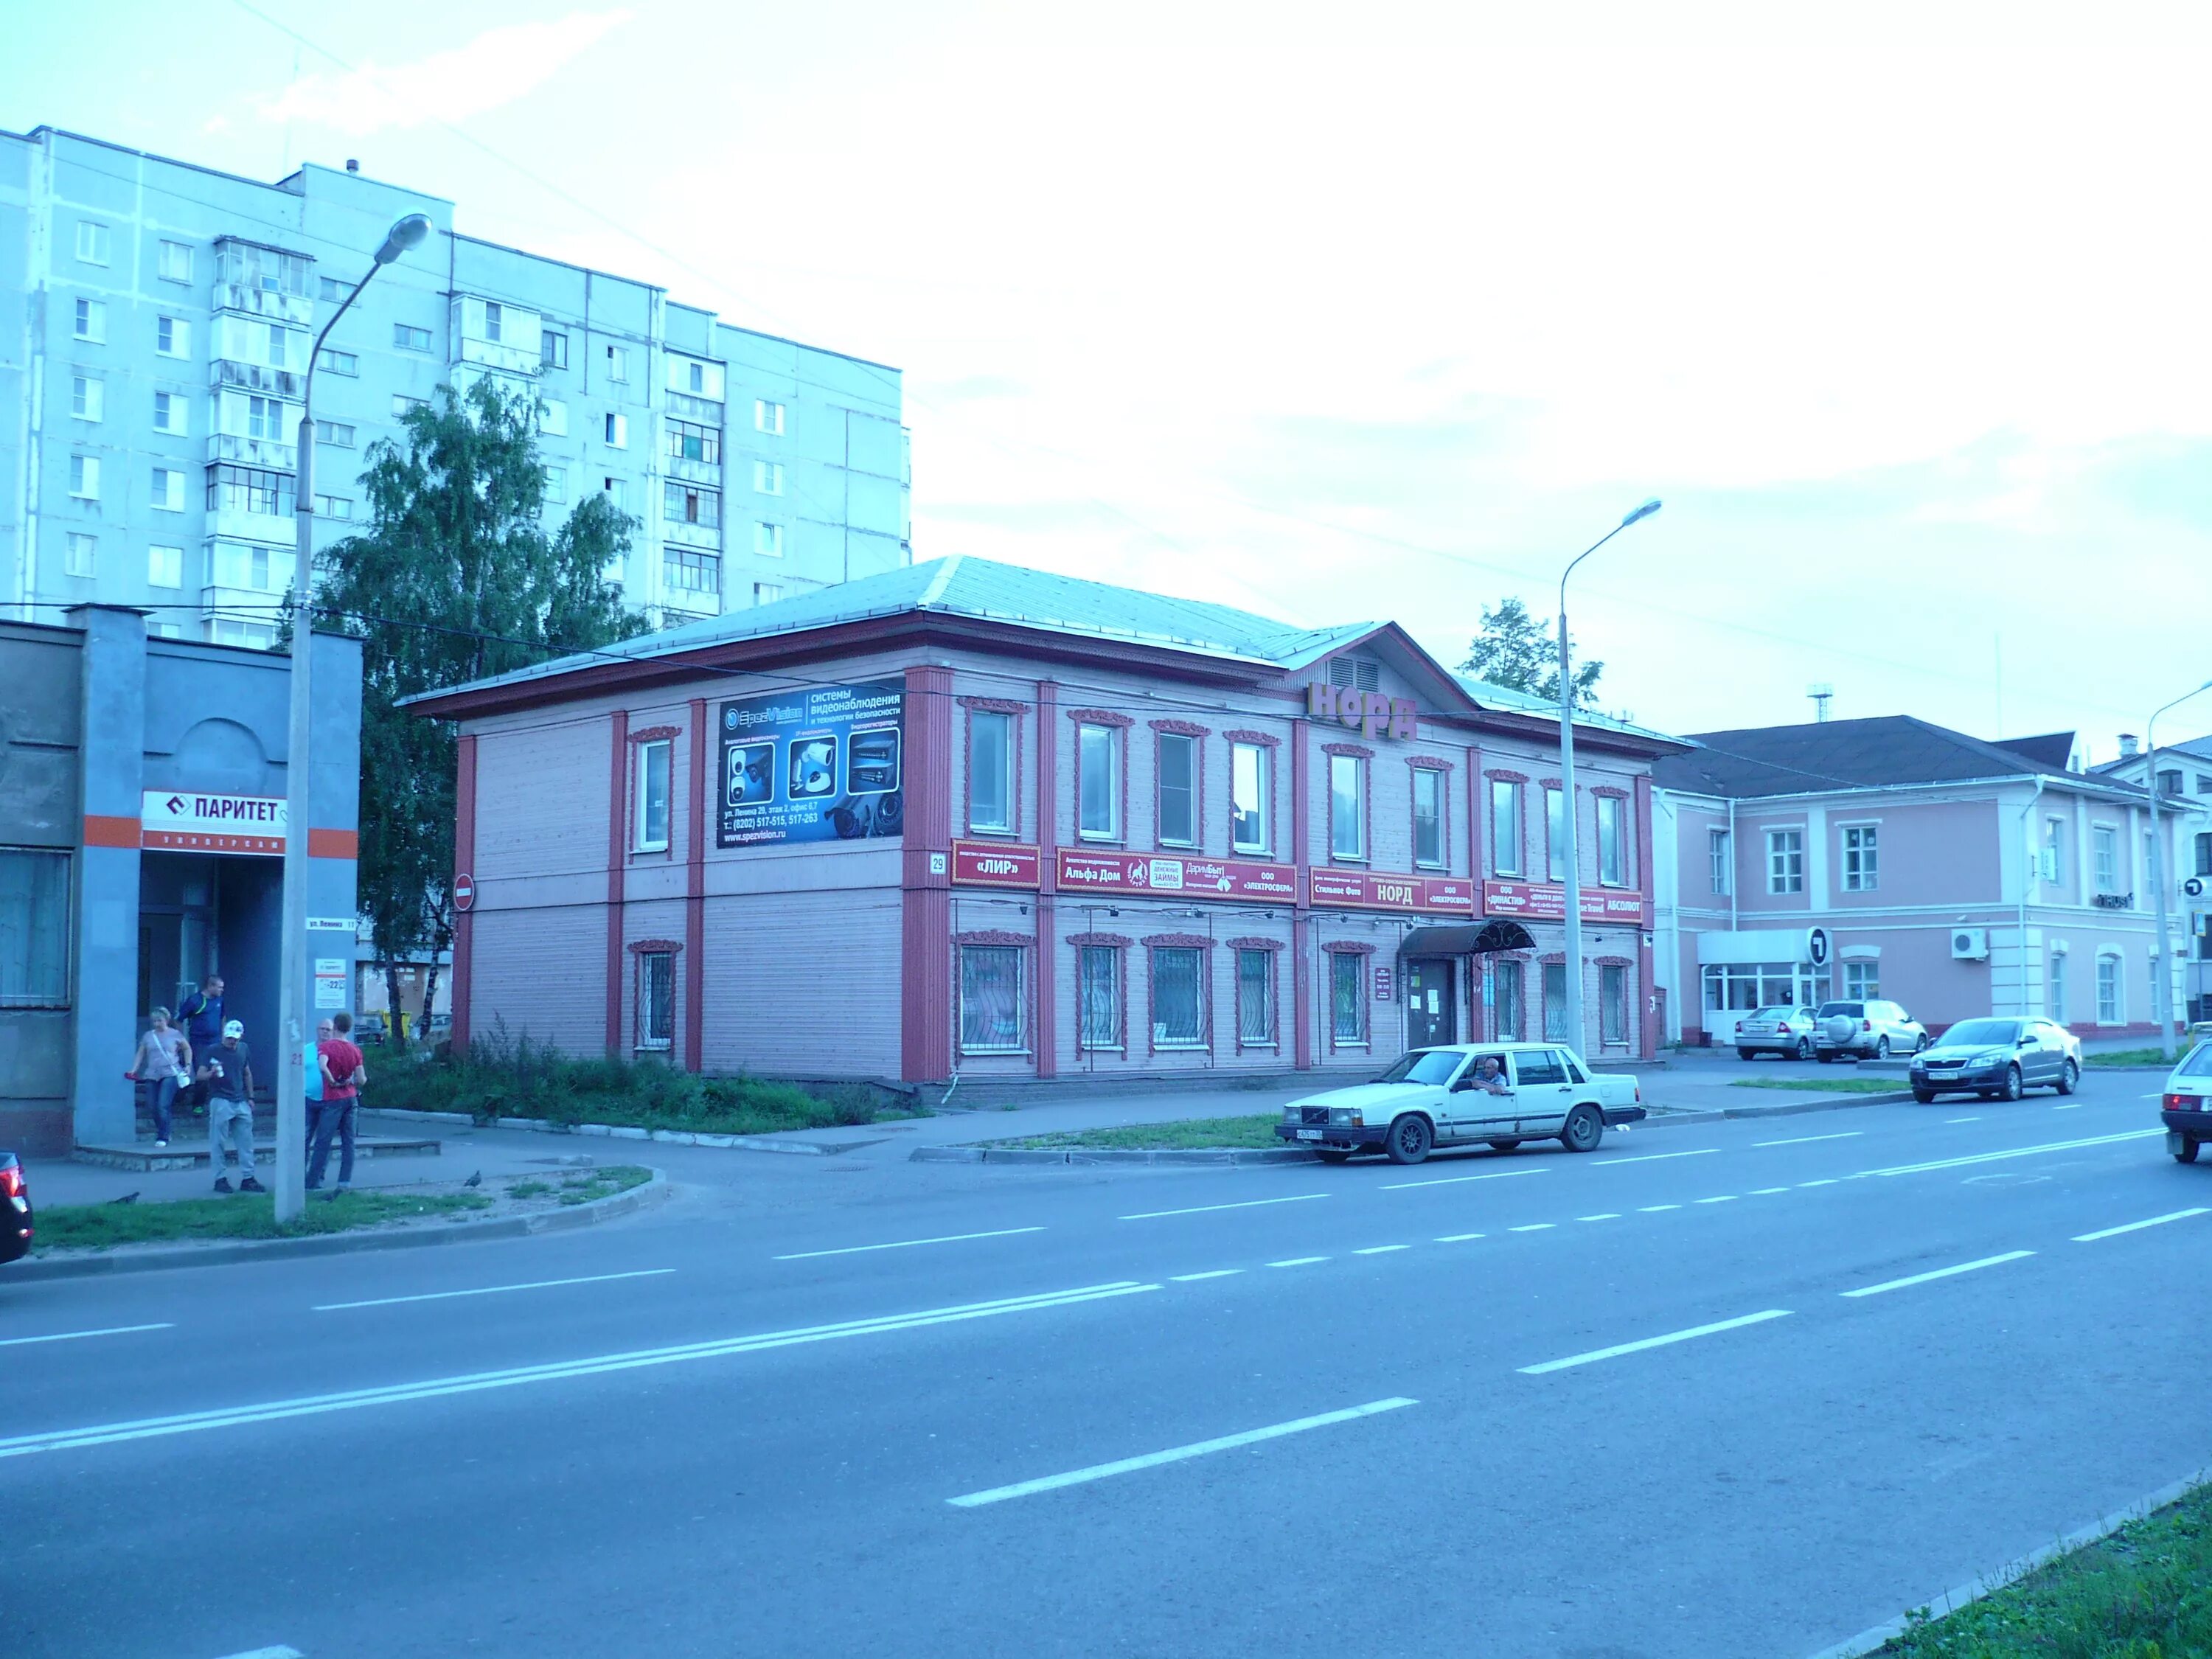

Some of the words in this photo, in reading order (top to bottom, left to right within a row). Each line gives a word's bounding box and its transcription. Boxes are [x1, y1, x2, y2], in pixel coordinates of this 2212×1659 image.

[811, 689, 852, 703] системы
[811, 694, 901, 716] видеонаблюдения
[816, 713, 854, 725] технологии
[855, 707, 901, 720] безопасности
[195, 798, 278, 821] ПАРИТЕТ
[725, 810, 734, 820] ул.
[735, 808, 757, 817] Ленина
[757, 815, 787, 827] 517-515,
[788, 813, 818, 824] 517-263
[724, 830, 787, 842] www.spezvision.ru
[933, 858, 944, 870] 29
[977, 859, 1019, 874] «ЛИР»
[1065, 866, 1098, 882] Альфа
[1099, 869, 1121, 883] Дом
[1155, 873, 1179, 883] ЗАЙМЫ
[1261, 872, 1274, 880] ООО
[1244, 881, 1293, 892] «ЭЛЕКТРОСФЕРА»
[1315, 884, 1344, 895] Стильное
[1345, 886, 1361, 896] Фото
[1444, 886, 1456, 894] ООО
[1377, 885, 1413, 905] НОРД
[1487, 894, 1526, 905] «ДИНАСТИЯ»
[1607, 900, 1641, 912] АБСОЛЮТ
[319, 920, 343, 928] Ленина
